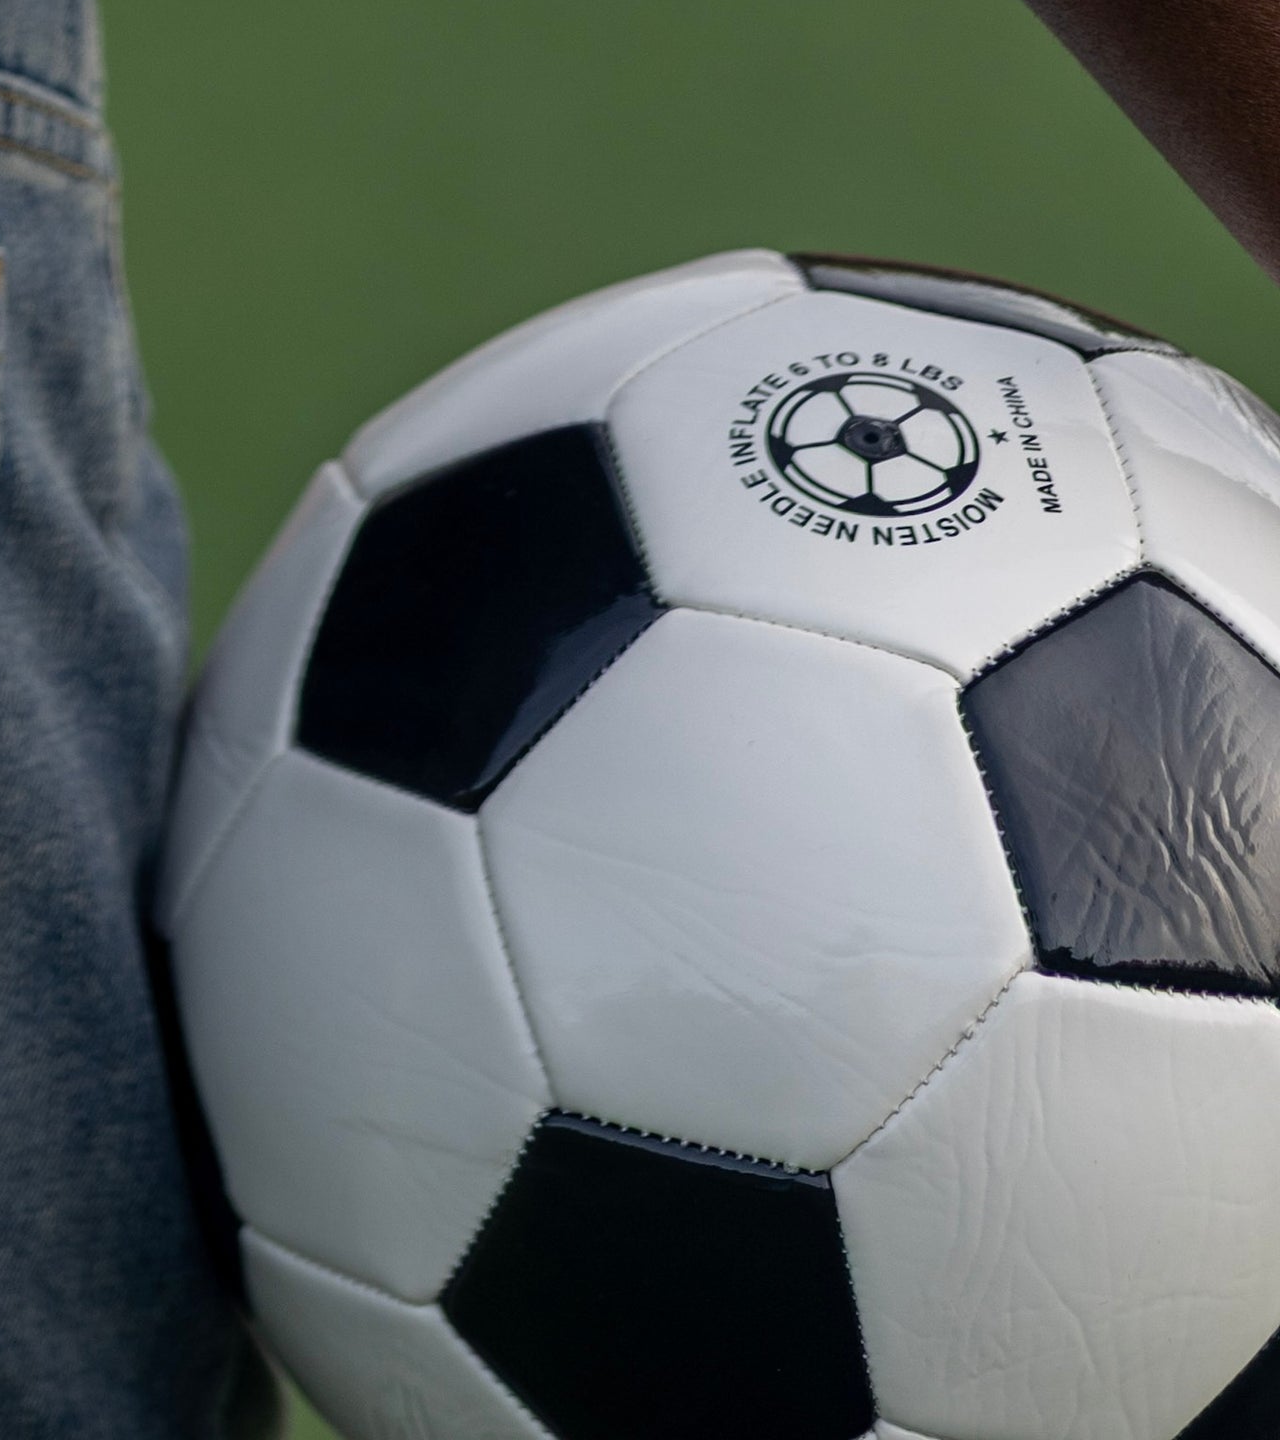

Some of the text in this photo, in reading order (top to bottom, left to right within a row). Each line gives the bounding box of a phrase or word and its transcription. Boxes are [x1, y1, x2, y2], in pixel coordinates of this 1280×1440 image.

[728, 351, 1006, 547] MOISTEN NEEDLE INFLATE 6 TO 8 LBS
[996, 376, 1064, 514] MADE IN CHINA
